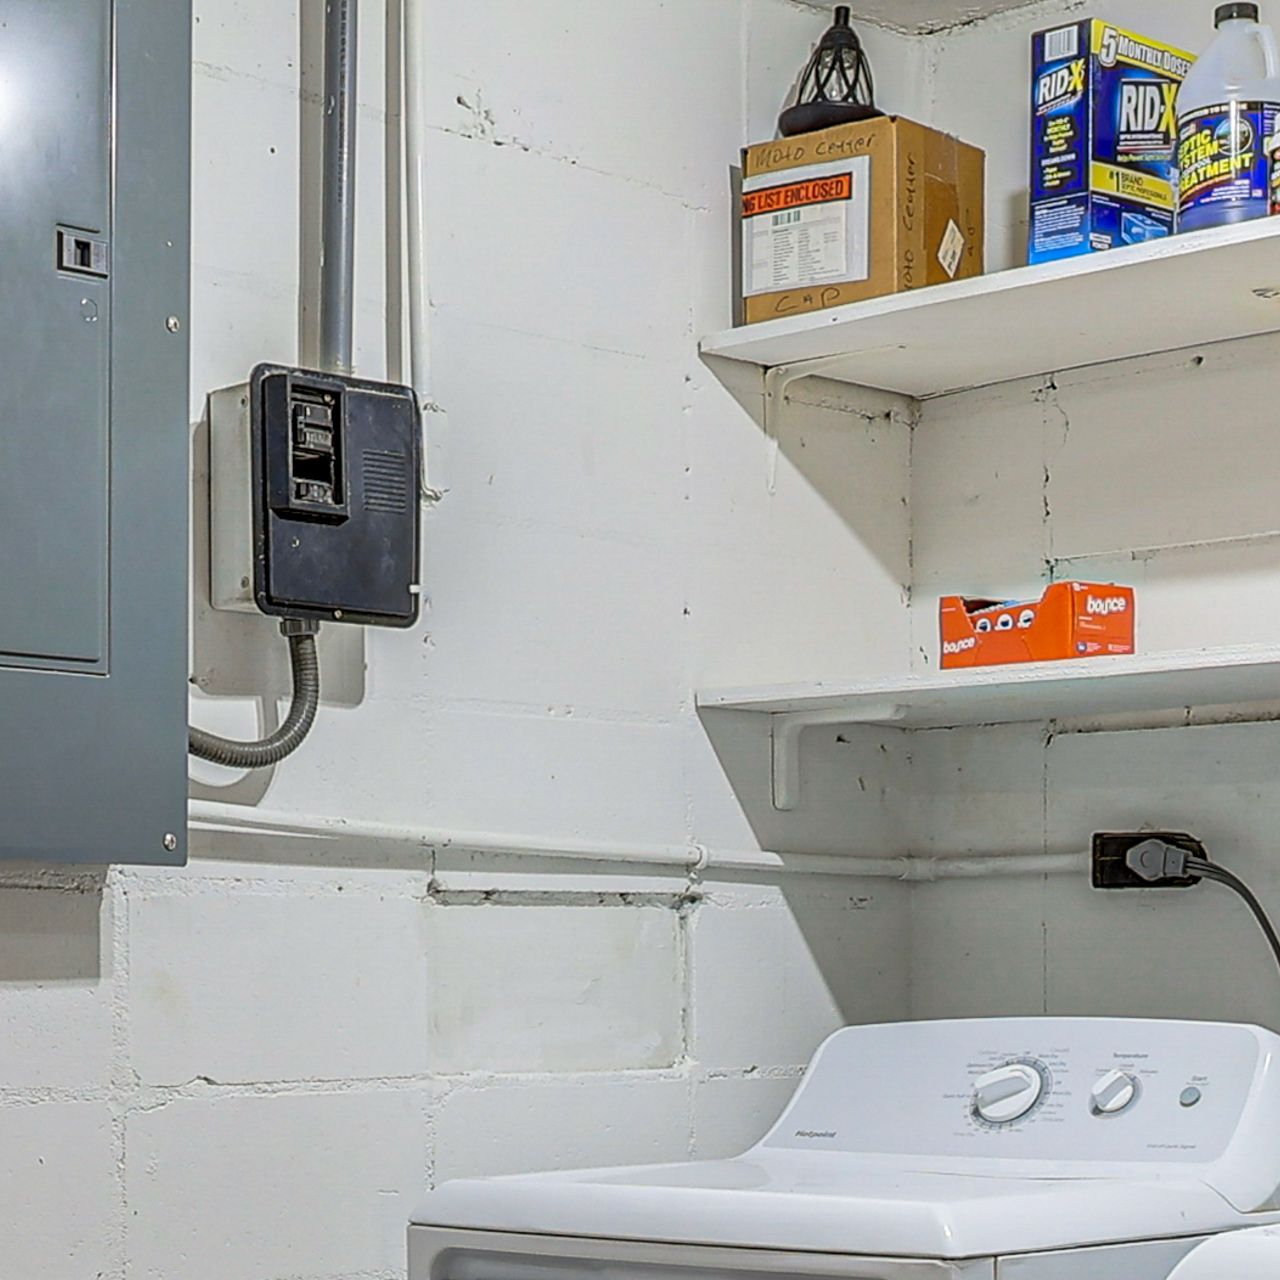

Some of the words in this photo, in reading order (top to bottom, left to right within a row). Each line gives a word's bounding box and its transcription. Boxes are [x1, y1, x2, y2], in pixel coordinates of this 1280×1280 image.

[1099, 27, 1118, 67] 5
[1118, 35, 1162, 67] MONTHLY
[1038, 58, 1086, 105] RID-X
[1120, 83, 1177, 139] RID-X
[1179, 129, 1211, 156] EPTIC
[1121, 172, 1144, 186] BRAND
[1179, 153, 1254, 193] EATMENT
[757, 191, 782, 210] LIST
[784, 179, 845, 206] ENCLOSED
[1086, 594, 1126, 616] bounce
[942, 637, 976, 654] bounce
[795, 1130, 837, 1138] Hotpoint
